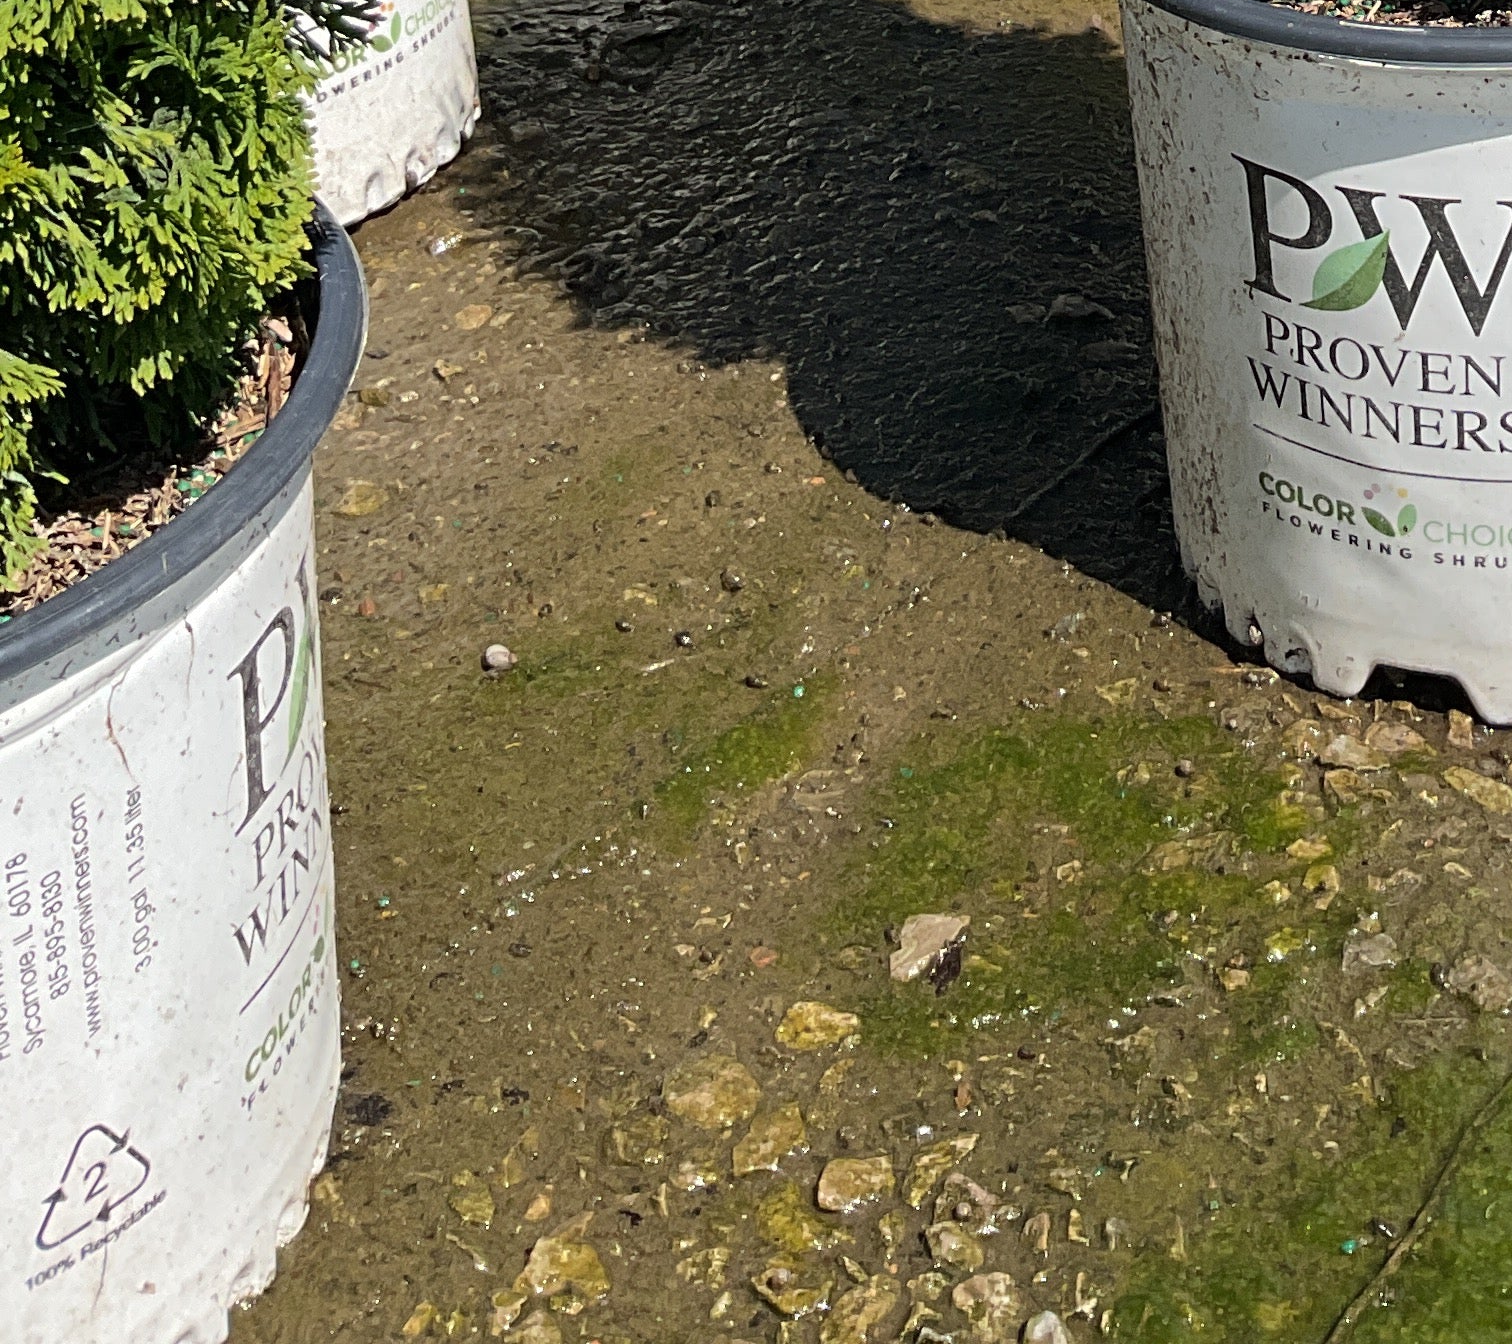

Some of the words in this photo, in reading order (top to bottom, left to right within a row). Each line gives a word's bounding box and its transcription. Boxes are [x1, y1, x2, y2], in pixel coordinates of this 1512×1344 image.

[1261, 310, 1507, 399] PROVEN
[1258, 470, 1356, 526] COLOR
[1262, 501, 1413, 560] FLOWERING
[124, 784, 141, 825] liter
[125, 822, 146, 884] 11.35
[6, 852, 32, 917] 60178
[70, 792, 102, 1039] www.provenwinners.com
[130, 887, 153, 924] gal
[13, 924, 34, 947] IL
[41, 870, 70, 1000] 815-895-8130
[132, 925, 152, 974] 3.00
[19, 945, 46, 1055] Sycamore,
[245, 962, 311, 1084] COLOR
[84, 1161, 109, 1204] 2
[25, 1253, 77, 1292] 100%
[80, 1189, 168, 1261] Recyclable
